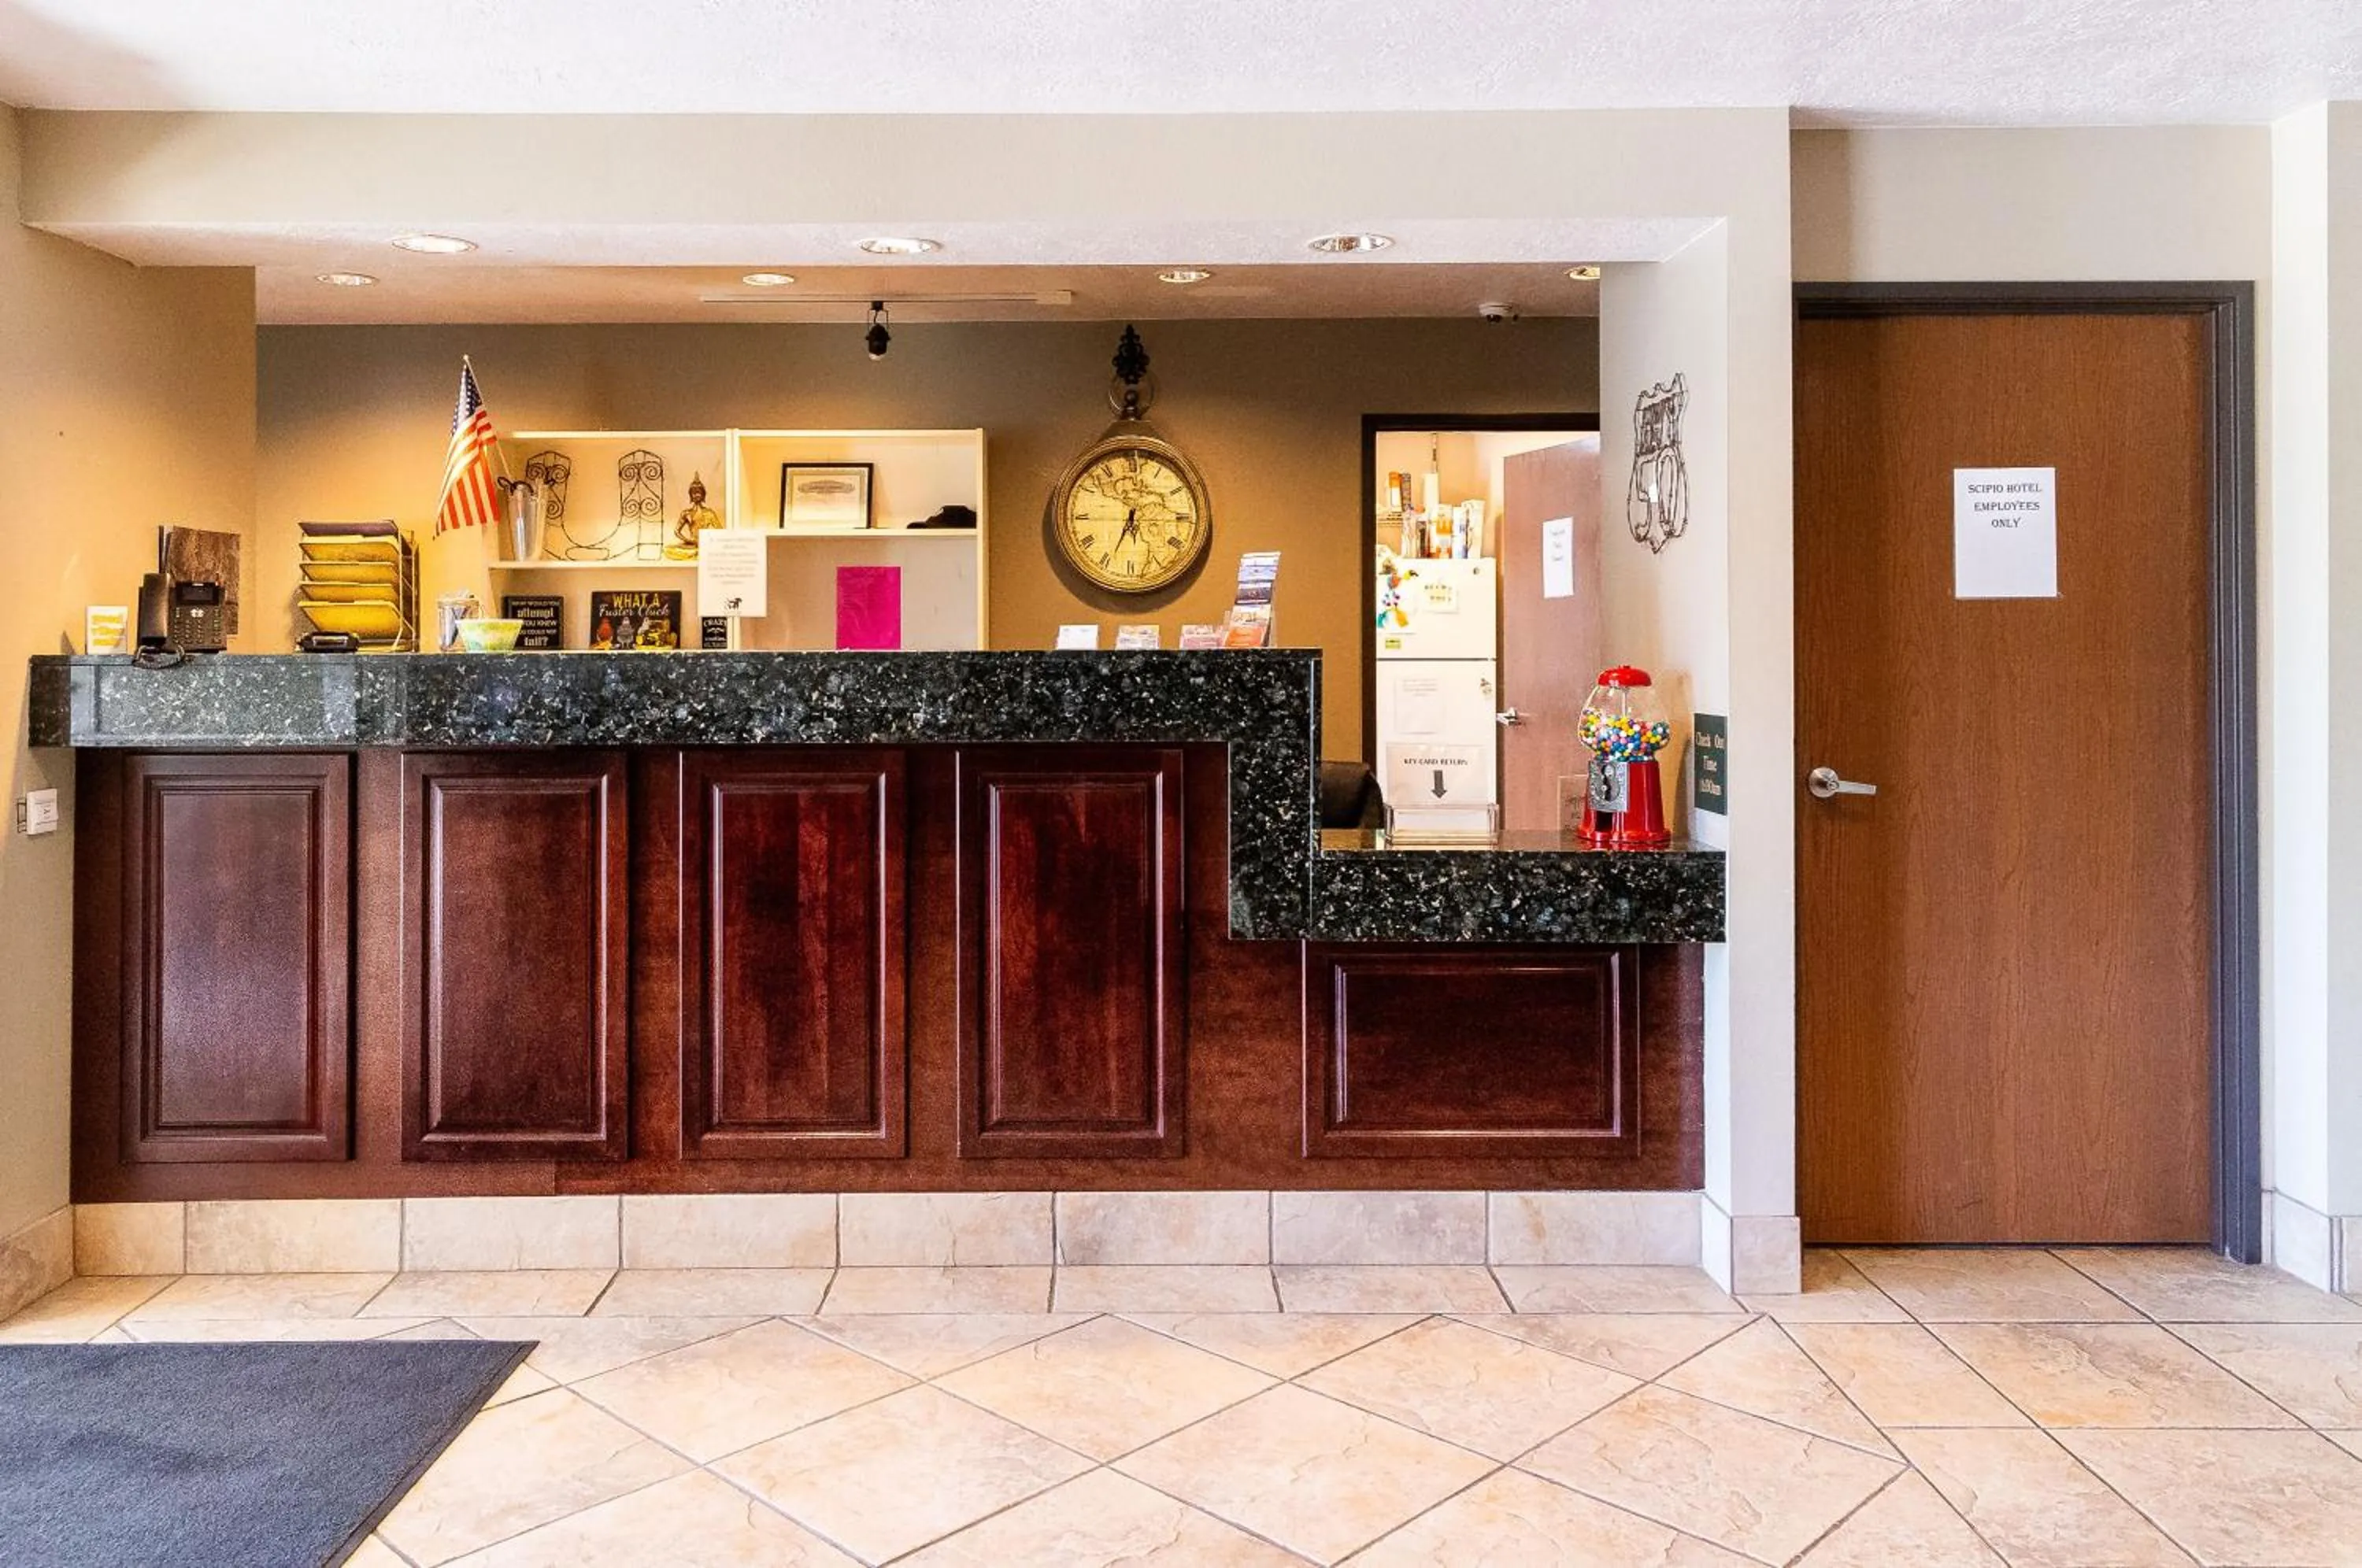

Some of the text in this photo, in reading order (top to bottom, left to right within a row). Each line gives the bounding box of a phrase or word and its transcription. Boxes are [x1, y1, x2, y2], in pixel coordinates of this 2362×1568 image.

[1968, 483, 2042, 494] SCIPIO HOTEL
[1974, 501, 2040, 512] EMPLOYEES
[1991, 516, 2021, 528] ONLY
[613, 593, 661, 607] WHAT A
